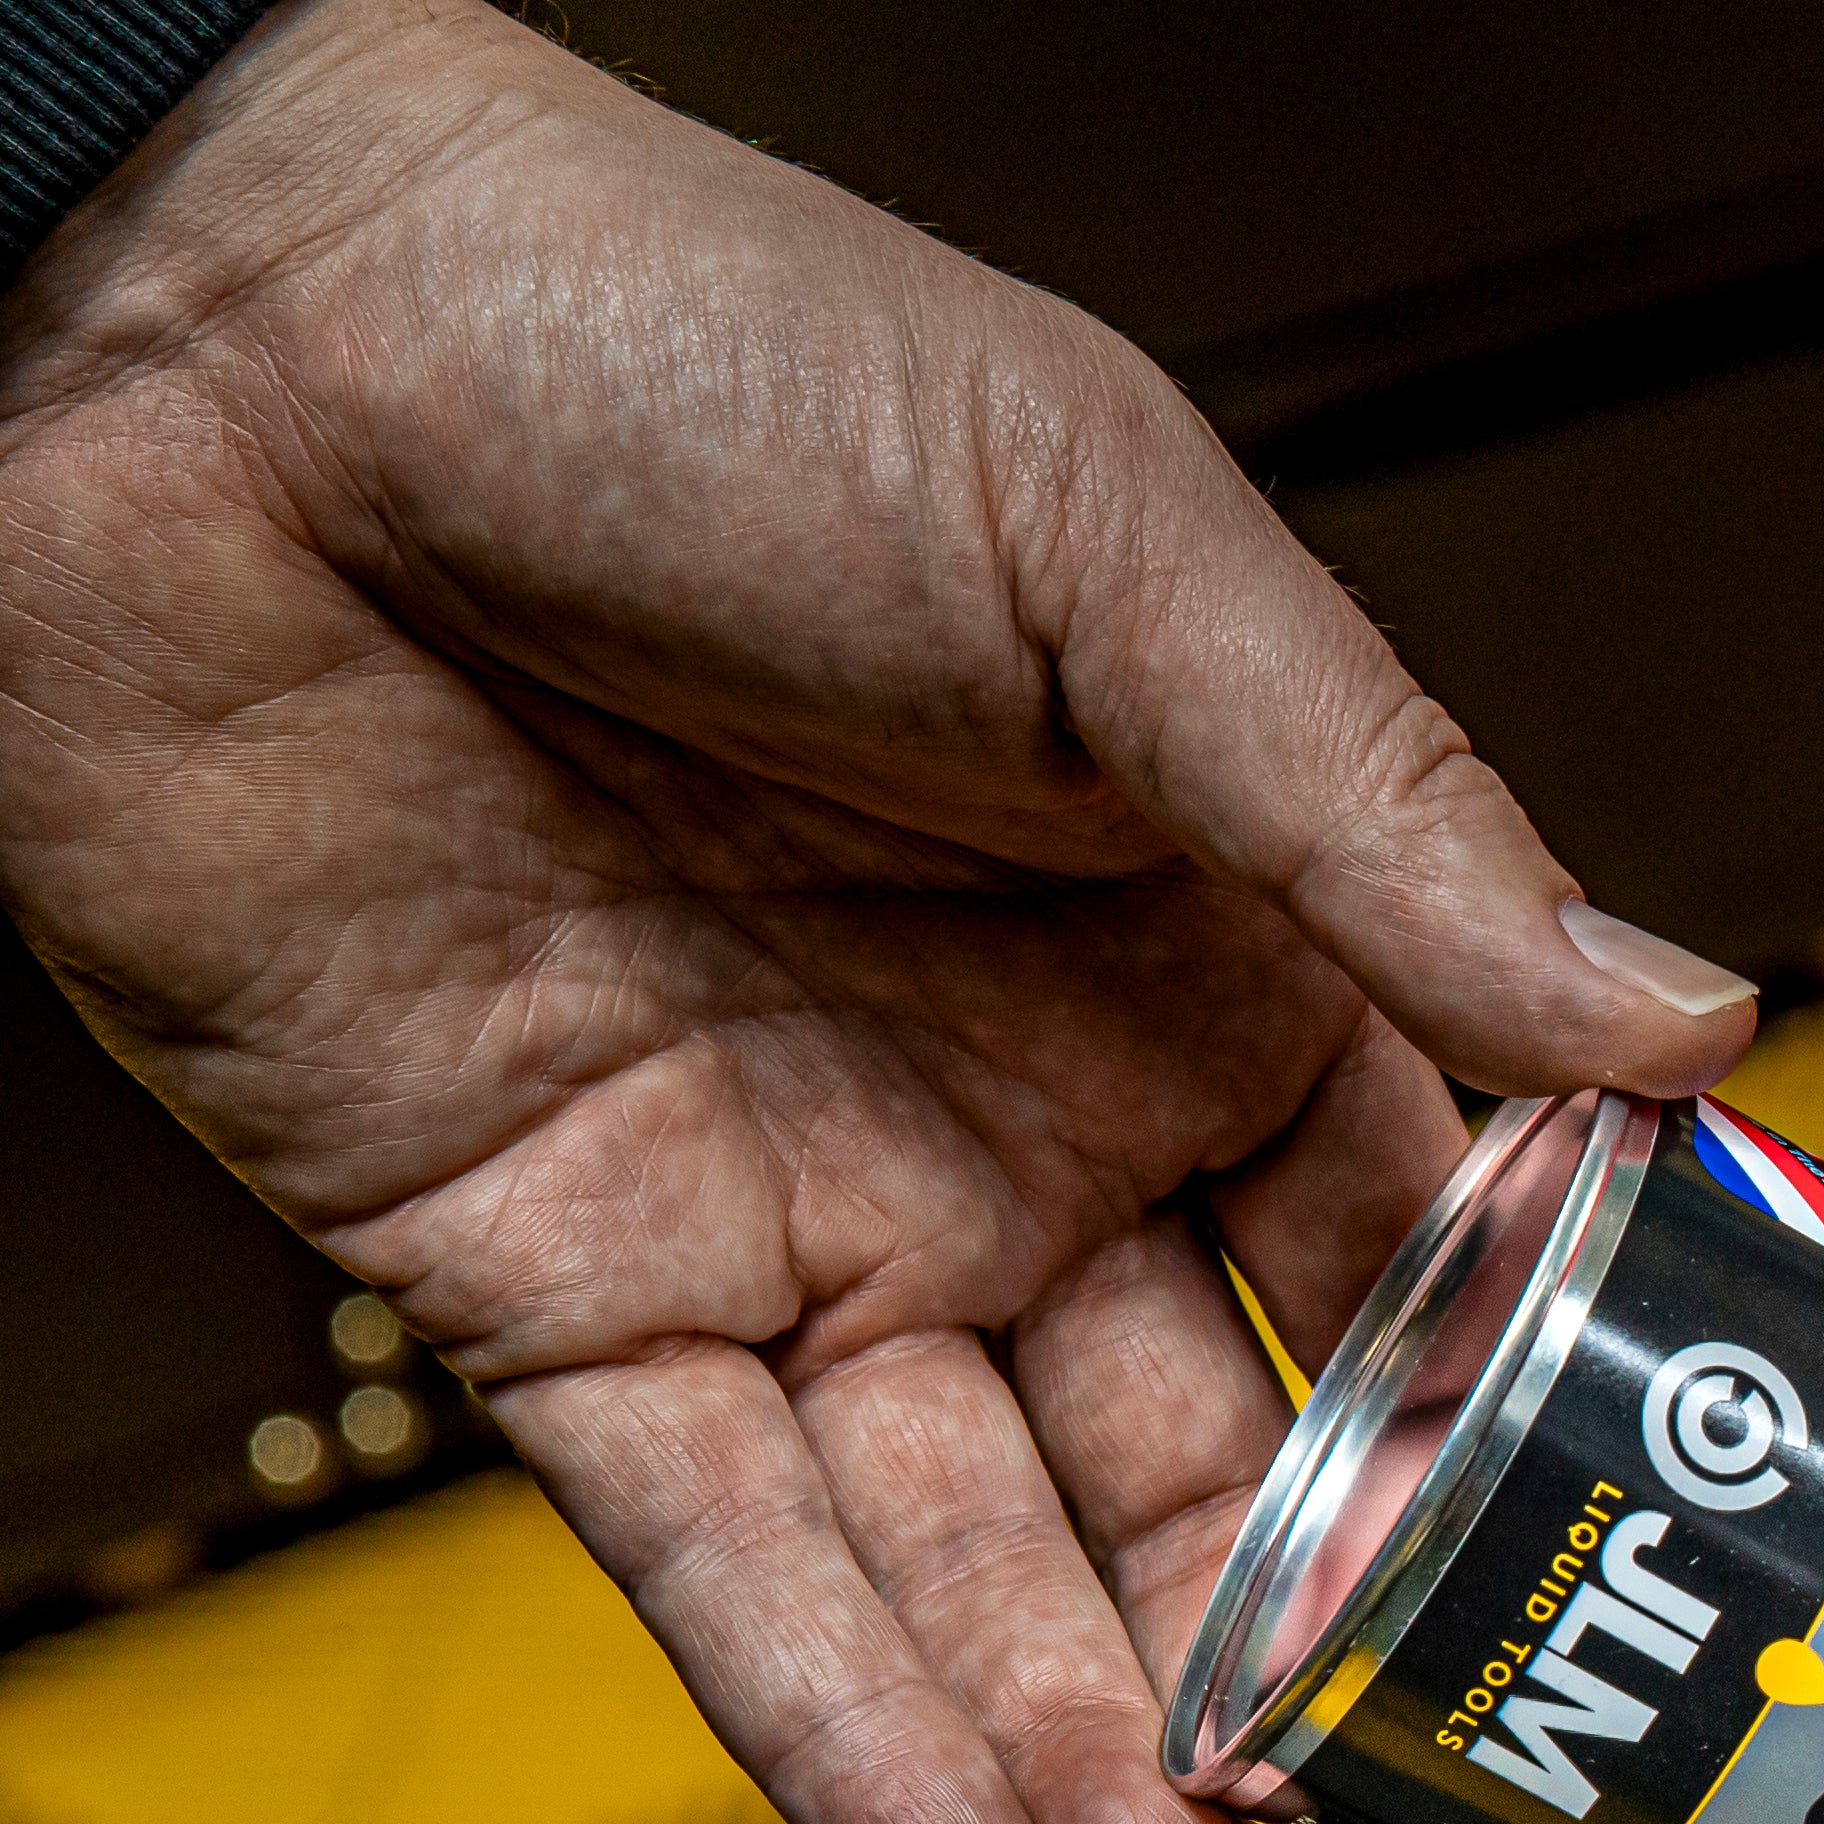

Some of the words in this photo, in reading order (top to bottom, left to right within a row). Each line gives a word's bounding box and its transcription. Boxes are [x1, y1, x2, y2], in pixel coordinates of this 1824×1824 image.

[1526, 1481, 1623, 1622] LIQUID
[1437, 1641, 1531, 1750] TOOLS
[1466, 1511, 1721, 1820] JLM
